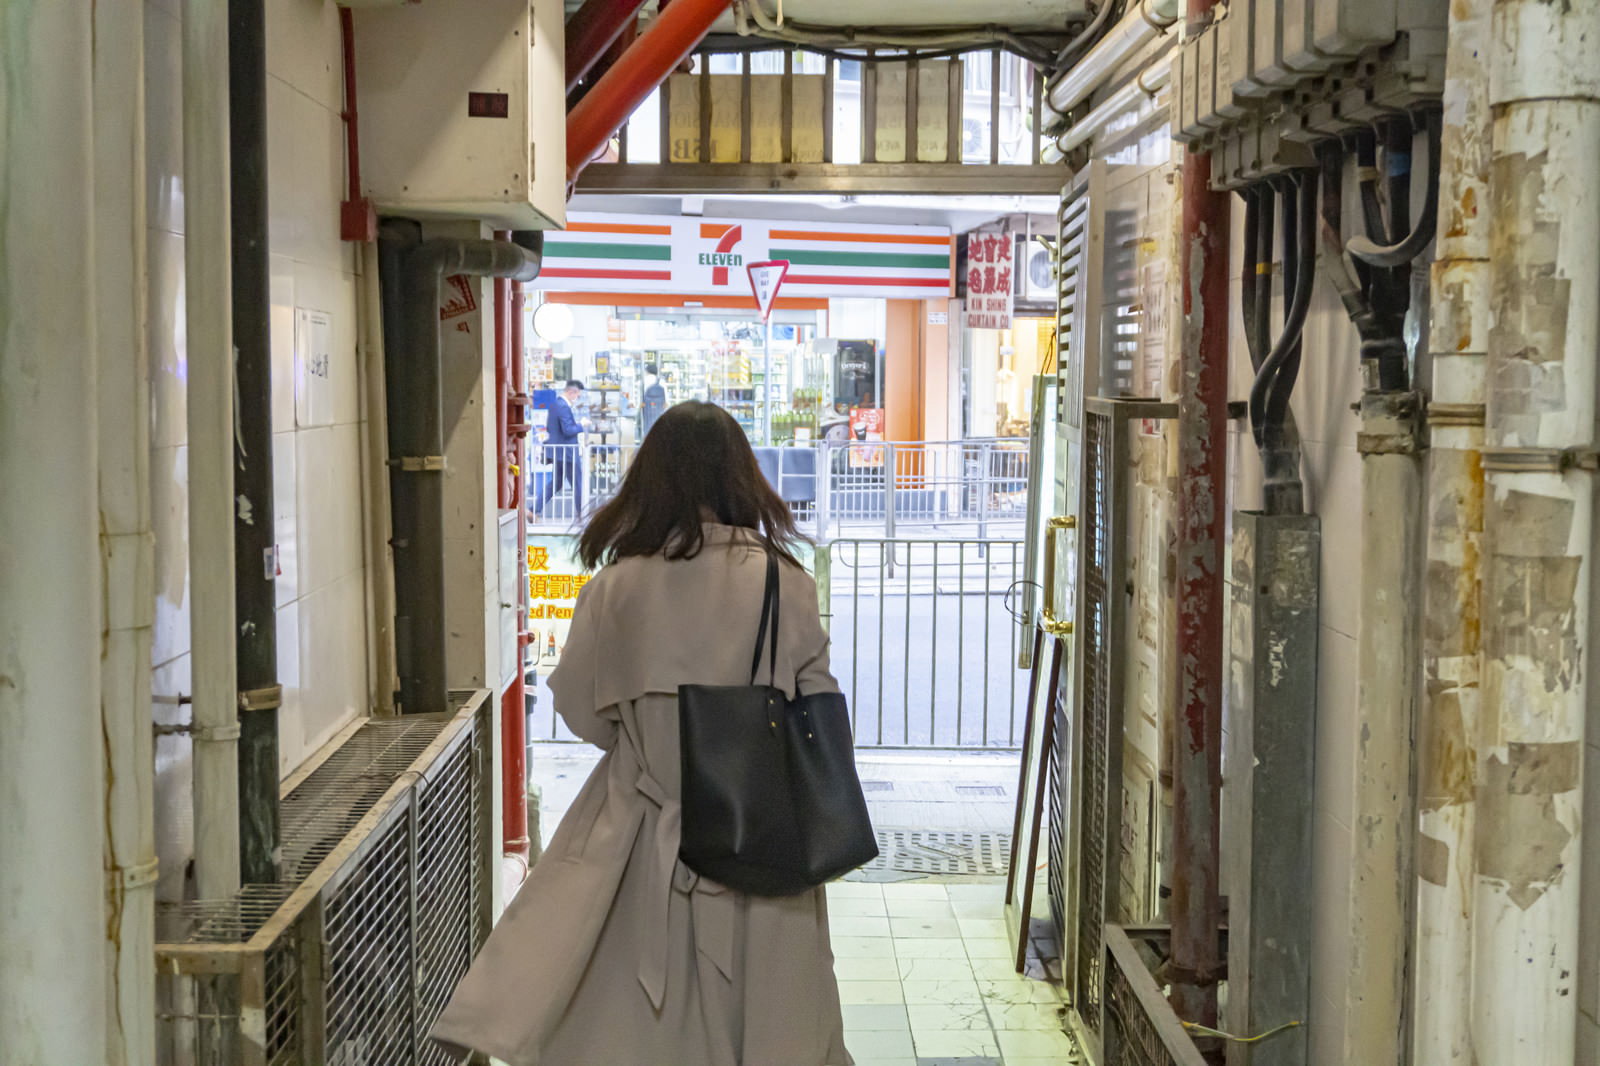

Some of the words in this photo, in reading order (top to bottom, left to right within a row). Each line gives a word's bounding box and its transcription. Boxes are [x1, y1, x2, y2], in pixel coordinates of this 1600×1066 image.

[700, 223, 742, 285] 7
[971, 298, 982, 311] KIN
[987, 298, 1007, 312] SHING
[968, 313, 996, 328] CURTAIN
